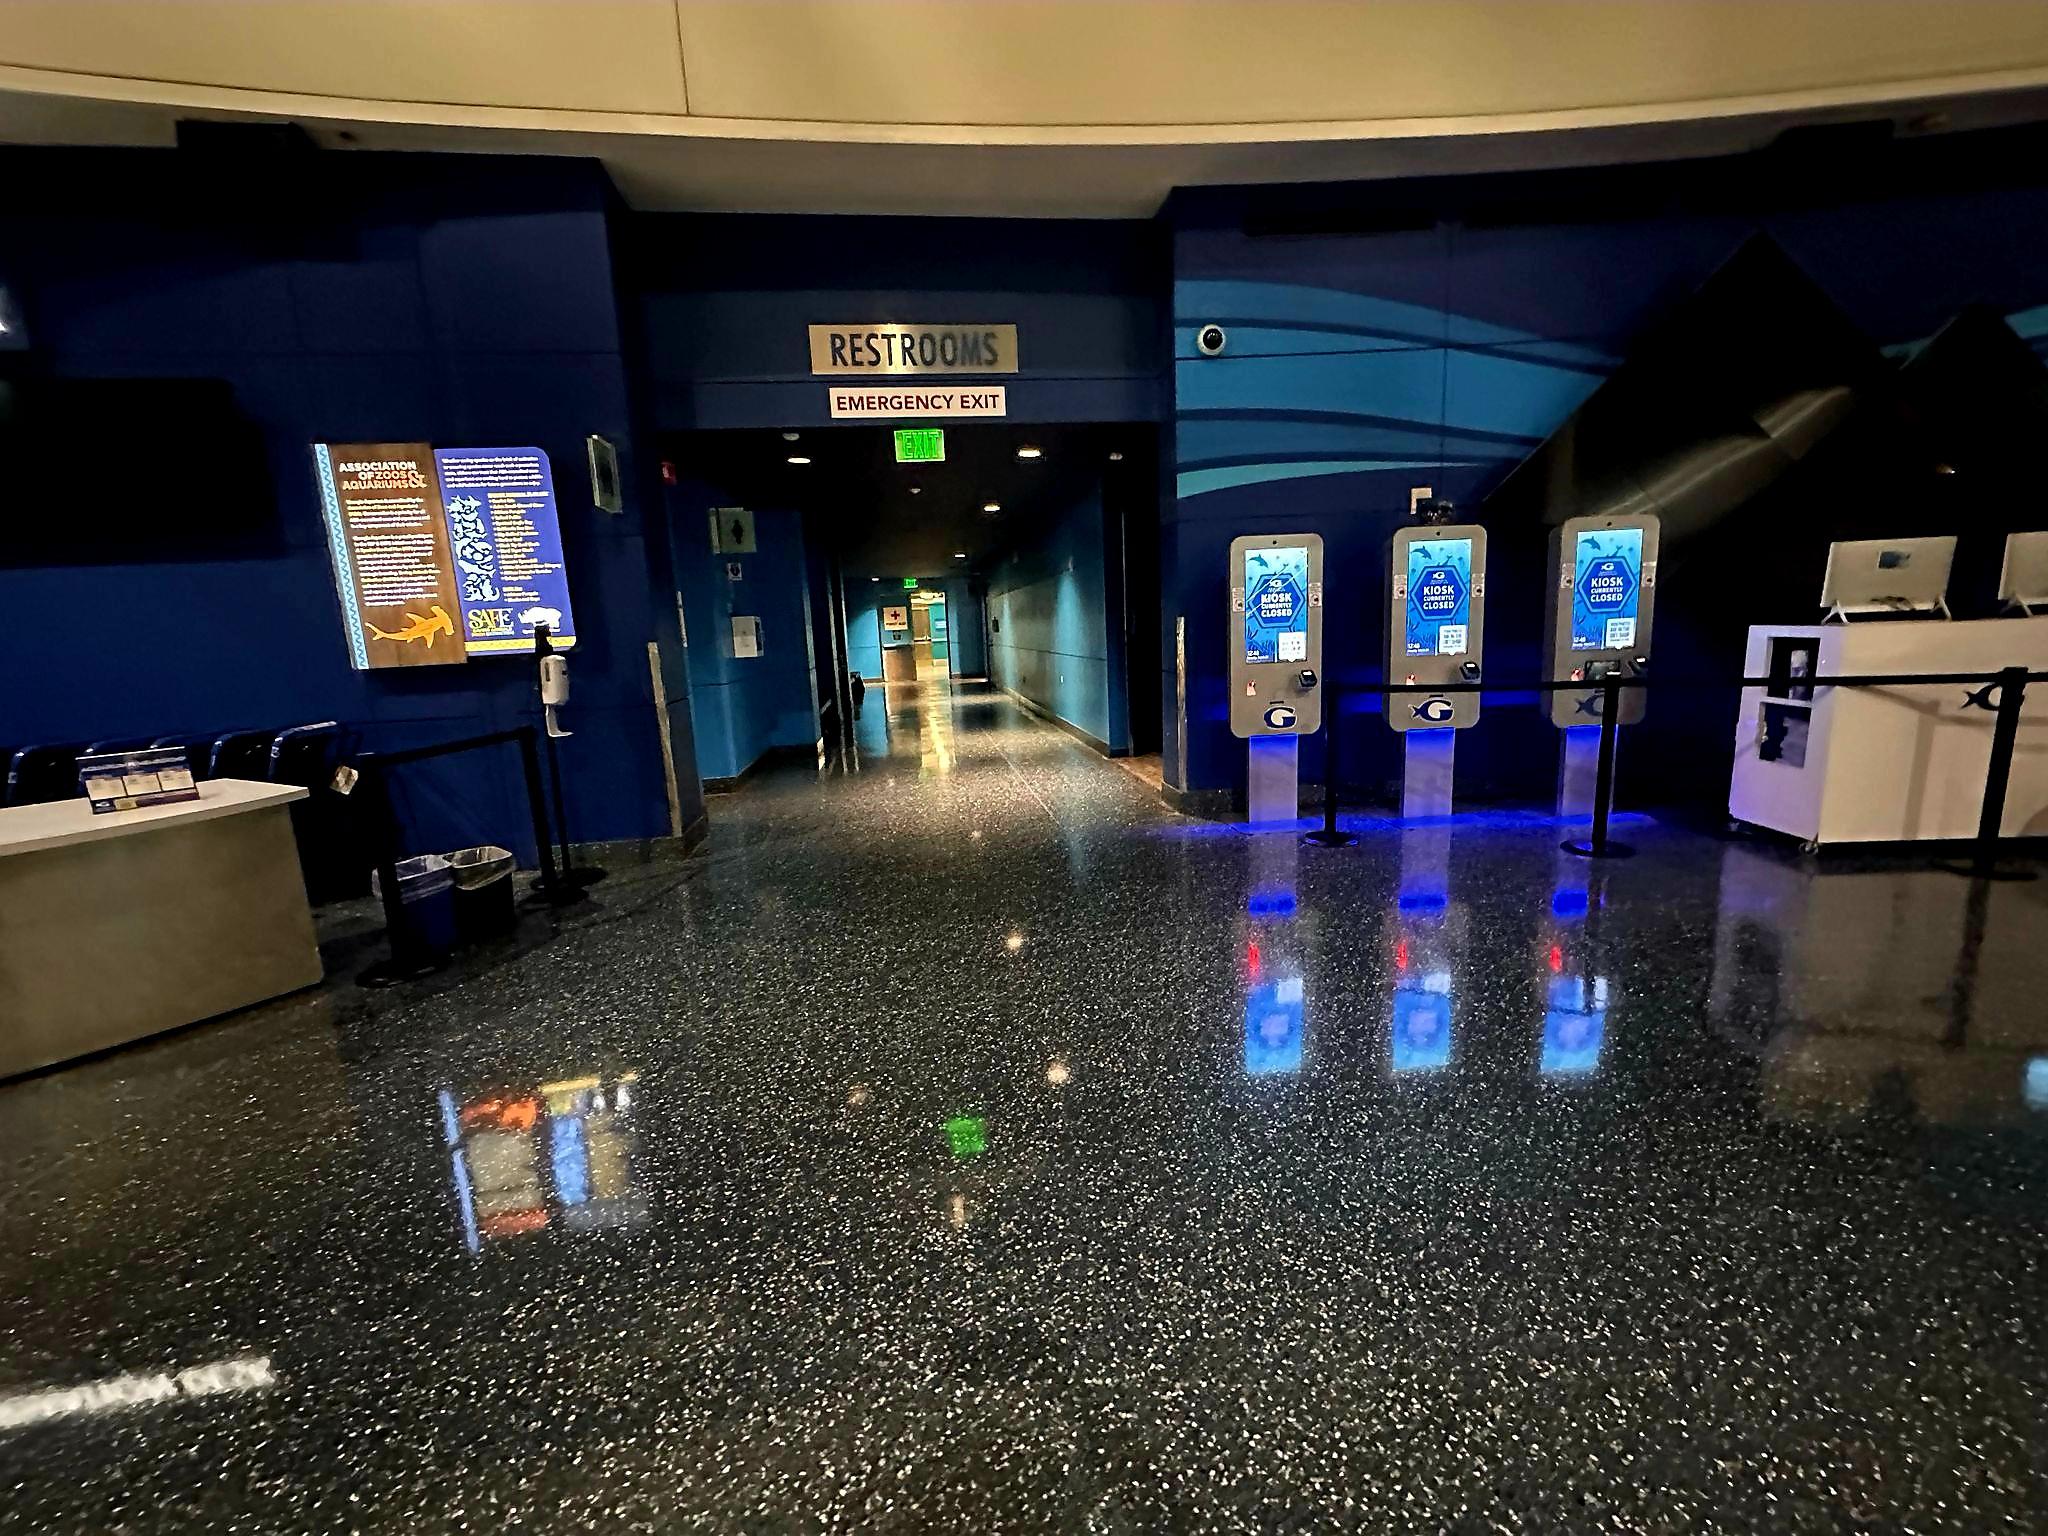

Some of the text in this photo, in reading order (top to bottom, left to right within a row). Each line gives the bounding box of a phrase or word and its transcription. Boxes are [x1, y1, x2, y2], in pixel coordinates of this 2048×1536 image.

[830, 332, 999, 367] RESTROOMS
[836, 394, 1000, 411] EMERGENCY EXIT
[902, 432, 940, 459] EXIT
[339, 461, 417, 473] ASSOCIATION
[342, 479, 409, 490] AQUARIUMS
[358, 470, 428, 489] OF ZOOS &
[1591, 577, 1624, 588] KIOSK
[1423, 585, 1455, 596] KIOSK
[1260, 592, 1292, 603] KIOSK
[1590, 593, 1623, 603] CLOSED
[1423, 601, 1455, 610] CLOSED
[467, 607, 515, 629] SAFE
[1261, 608, 1293, 618] CLOSED
